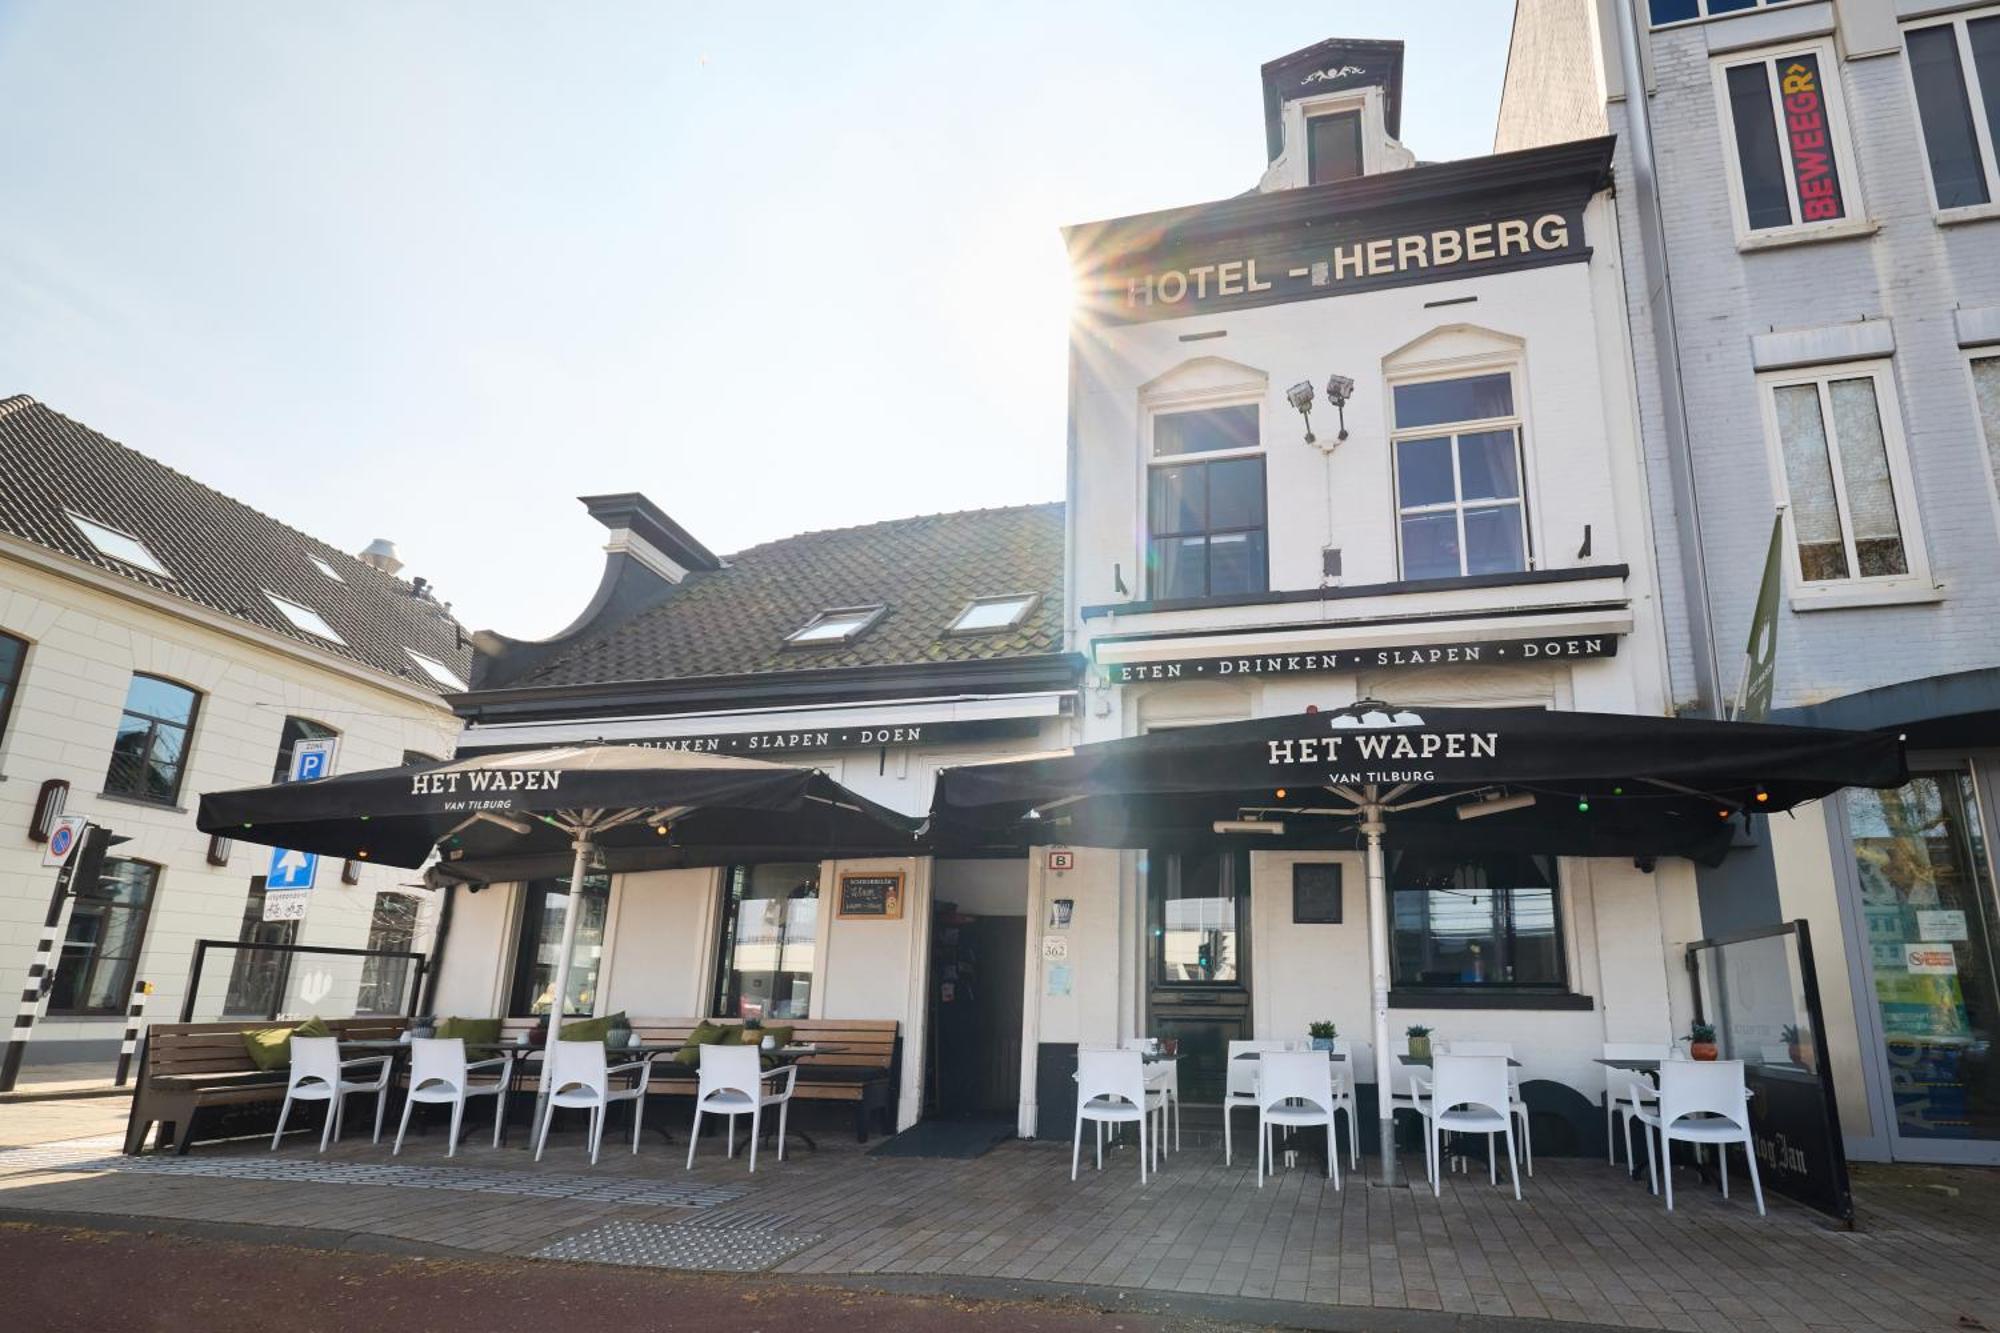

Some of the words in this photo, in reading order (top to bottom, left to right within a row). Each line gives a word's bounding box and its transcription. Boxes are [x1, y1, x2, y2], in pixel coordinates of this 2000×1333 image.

[1127, 258, 1272, 308] HOTEL
[1334, 213, 1569, 280] HERBERG
[1121, 663, 1183, 680] ETEN
[1219, 654, 1338, 674] DRINKEN
[1378, 646, 1481, 665] SLAPEN
[1523, 638, 1603, 658] DOEN
[749, 732, 829, 749] SLAPEN
[861, 727, 922, 743] DOEN
[1267, 736, 1343, 764] HET
[1355, 732, 1499, 760] WAPEN
[303, 756, 319, 776] P
[411, 772, 461, 795] HET
[467, 769, 562, 792] WAPEN
[1329, 773, 1361, 784] VAN
[1366, 771, 1435, 783] TILBURG
[444, 801, 465, 811] VAN
[468, 800, 512, 810] TILBURG
[1056, 856, 1066, 866] B
[1045, 946, 1065, 956] 362
